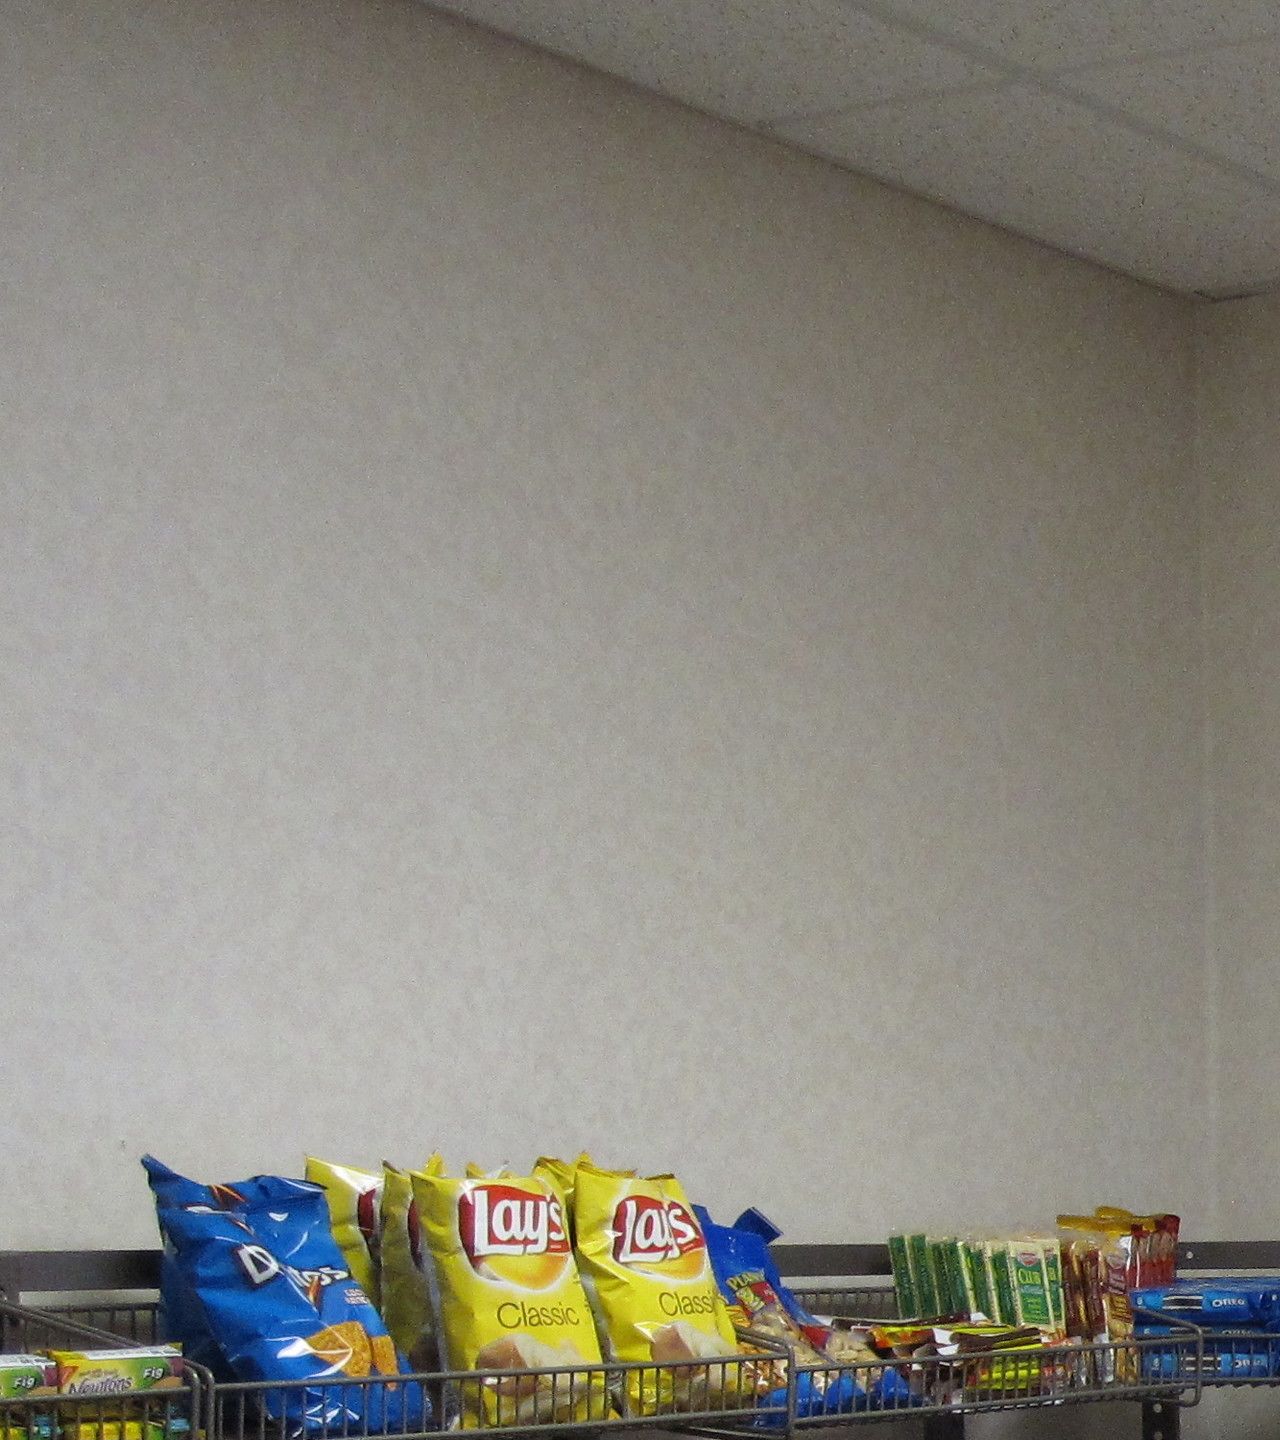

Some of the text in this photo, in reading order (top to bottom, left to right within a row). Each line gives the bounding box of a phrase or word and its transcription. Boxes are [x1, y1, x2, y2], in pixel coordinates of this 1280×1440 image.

[473, 1188, 567, 1257] Lay's
[496, 1302, 580, 1330] Classic
[658, 1291, 716, 1317] Class
[13, 1375, 37, 1389] Fig
[143, 1367, 164, 1379] Fig
